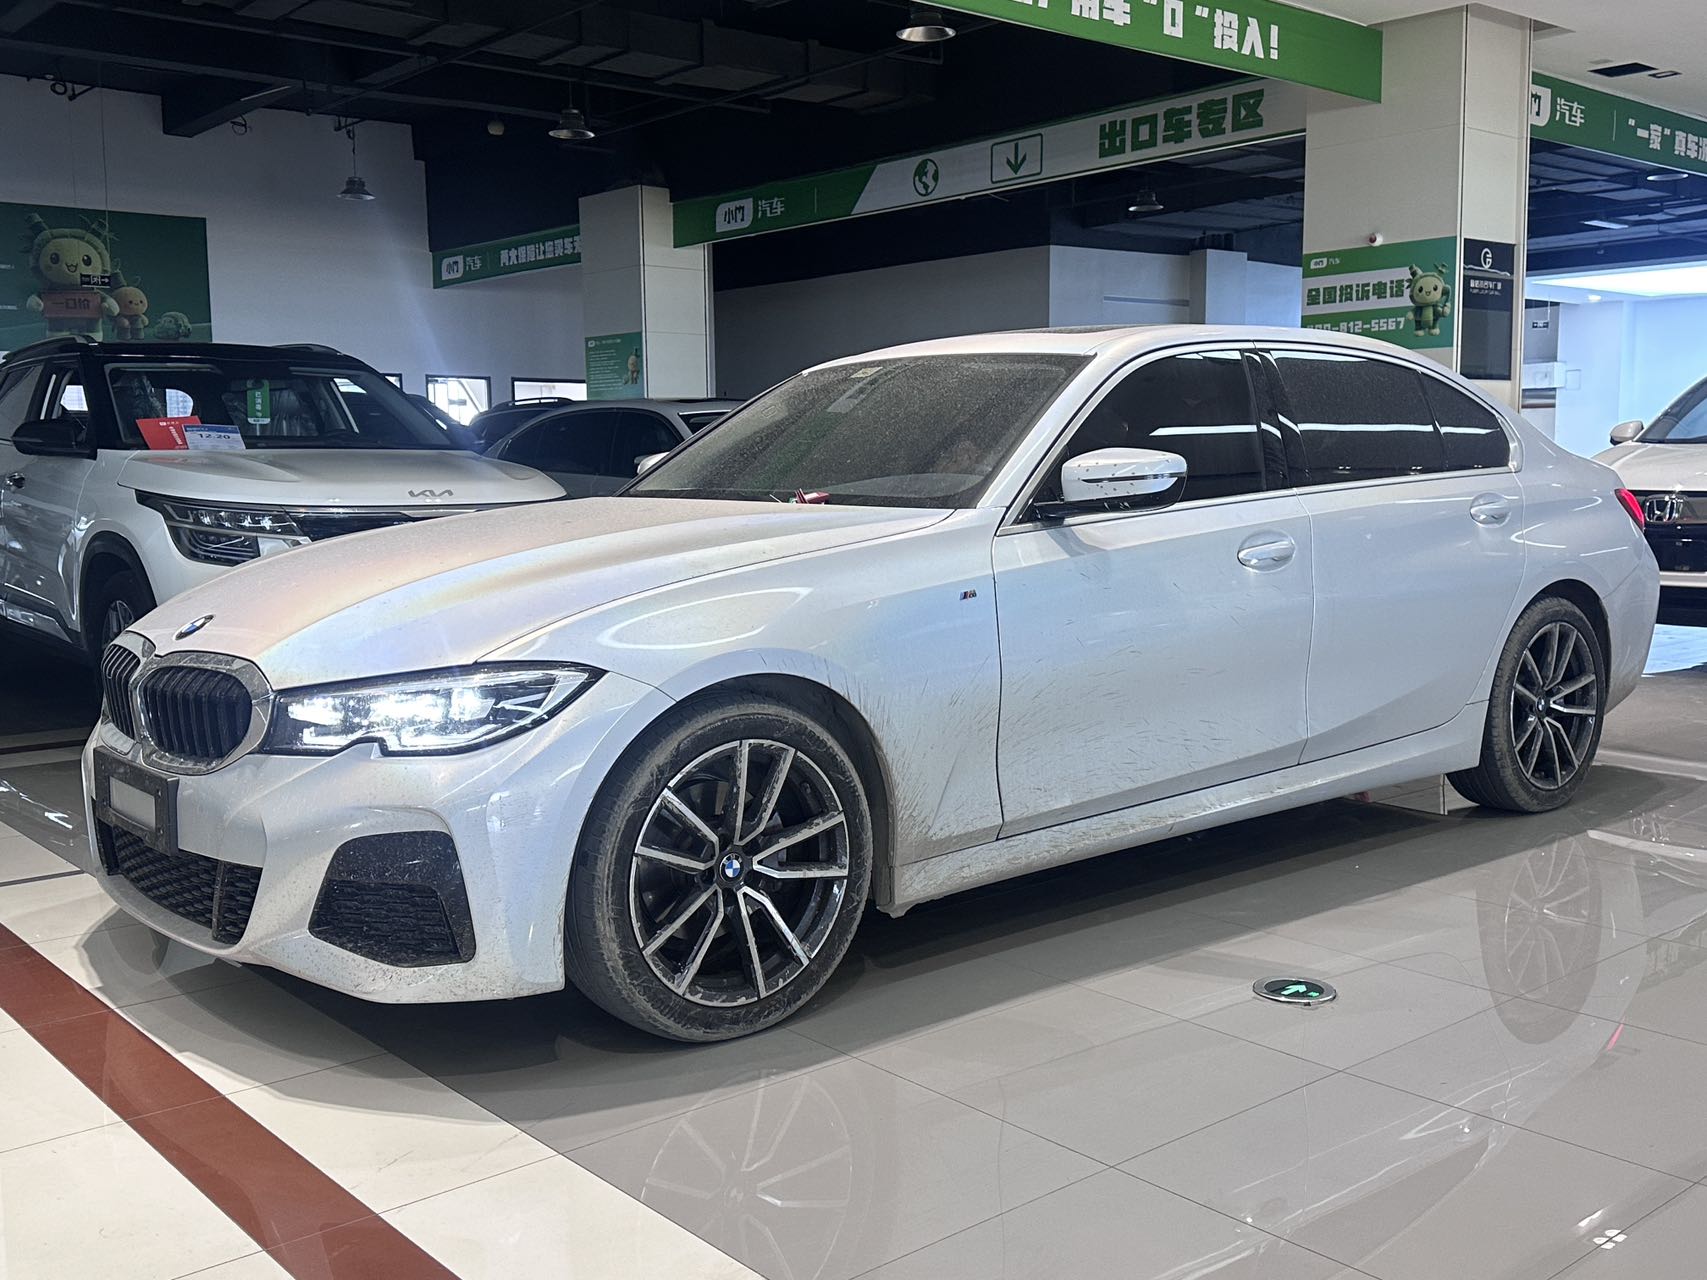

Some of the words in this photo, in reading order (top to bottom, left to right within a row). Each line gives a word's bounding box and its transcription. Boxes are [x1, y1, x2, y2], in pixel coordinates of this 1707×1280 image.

[1098, 88, 1265, 159] 出口车专区
[1556, 97, 1585, 127] 汽车
[758, 196, 785, 219] 汽车
[1306, 279, 1405, 306] 全国投诉电话
